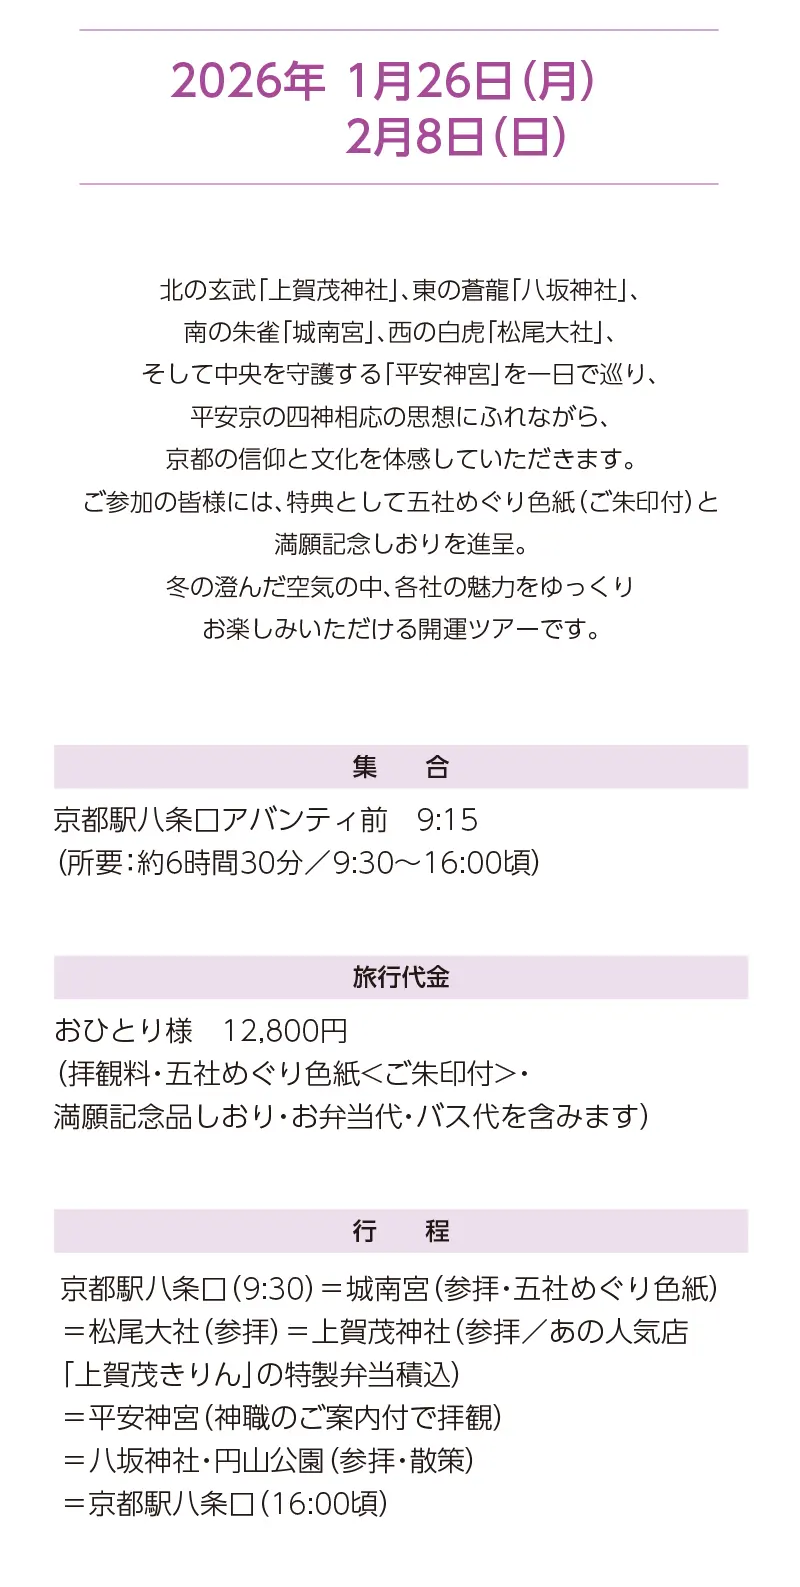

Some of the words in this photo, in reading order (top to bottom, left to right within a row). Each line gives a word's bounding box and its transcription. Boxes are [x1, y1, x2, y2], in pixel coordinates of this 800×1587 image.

[171, 60, 325, 101] 2026年
[160, 278, 637, 302] 北の玄武「上賀茂神社」、東の蒼龍「八坂神社」、
[184, 320, 613, 344] 南の朱雀「城南宮」、西の白虎「松尾大社」、
[143, 362, 655, 386] そして中央を守護する「平安神宮」を一日で巡り、
[191, 405, 607, 428] 平安京の四神相応の思想にふれながら、
[166, 447, 633, 470] 京都の信仰と文化を体感していただきます。
[275, 532, 524, 555] 満願記念しおりを進呈。
[167, 575, 631, 598] 冬の澄んだ空気の中、各社の魅力をゆっくり
[204, 617, 597, 640] お楽しみいただける開運ツアーです。
[54, 805, 387, 833] 京都駅八条口アバンティ前
[418, 808, 477, 831] 9:15
[353, 965, 449, 988] 旅行代金
[56, 1017, 192, 1044] おひとり様
[225, 1019, 346, 1043] 12,800円
